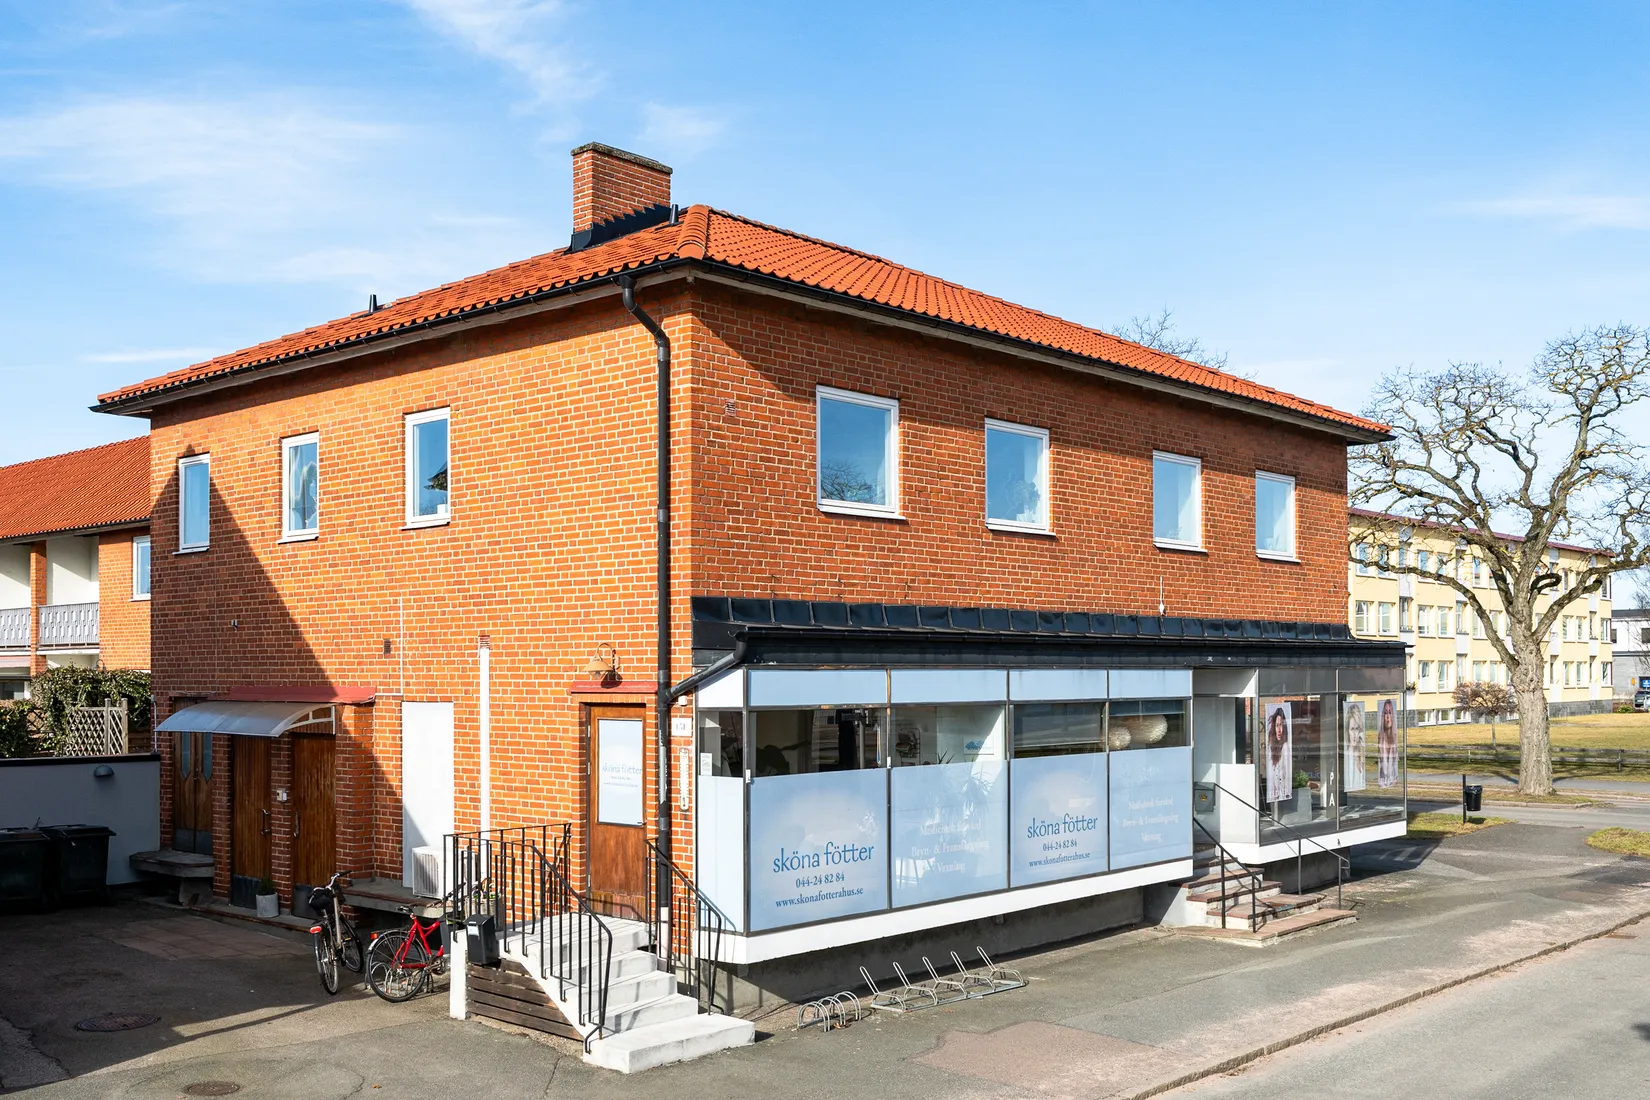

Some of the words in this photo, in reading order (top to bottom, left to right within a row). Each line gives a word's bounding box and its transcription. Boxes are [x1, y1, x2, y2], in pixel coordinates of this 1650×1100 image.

[1027, 817, 1060, 839] sköna
[1062, 812, 1098, 833] fötter
[1043, 842, 1062, 851] 044-24
[1062, 839, 1069, 848] 82
[1070, 838, 1077, 847] 84
[773, 847, 820, 873] sköna
[824, 841, 875, 866] fötter
[1029, 852, 1090, 867] www.skonafotterahus.se
[796, 875, 822, 888] 044-24
[824, 872, 834, 884] 82
[835, 871, 845, 882] 84
[775, 886, 864, 908] www.skonafotterahus.se
